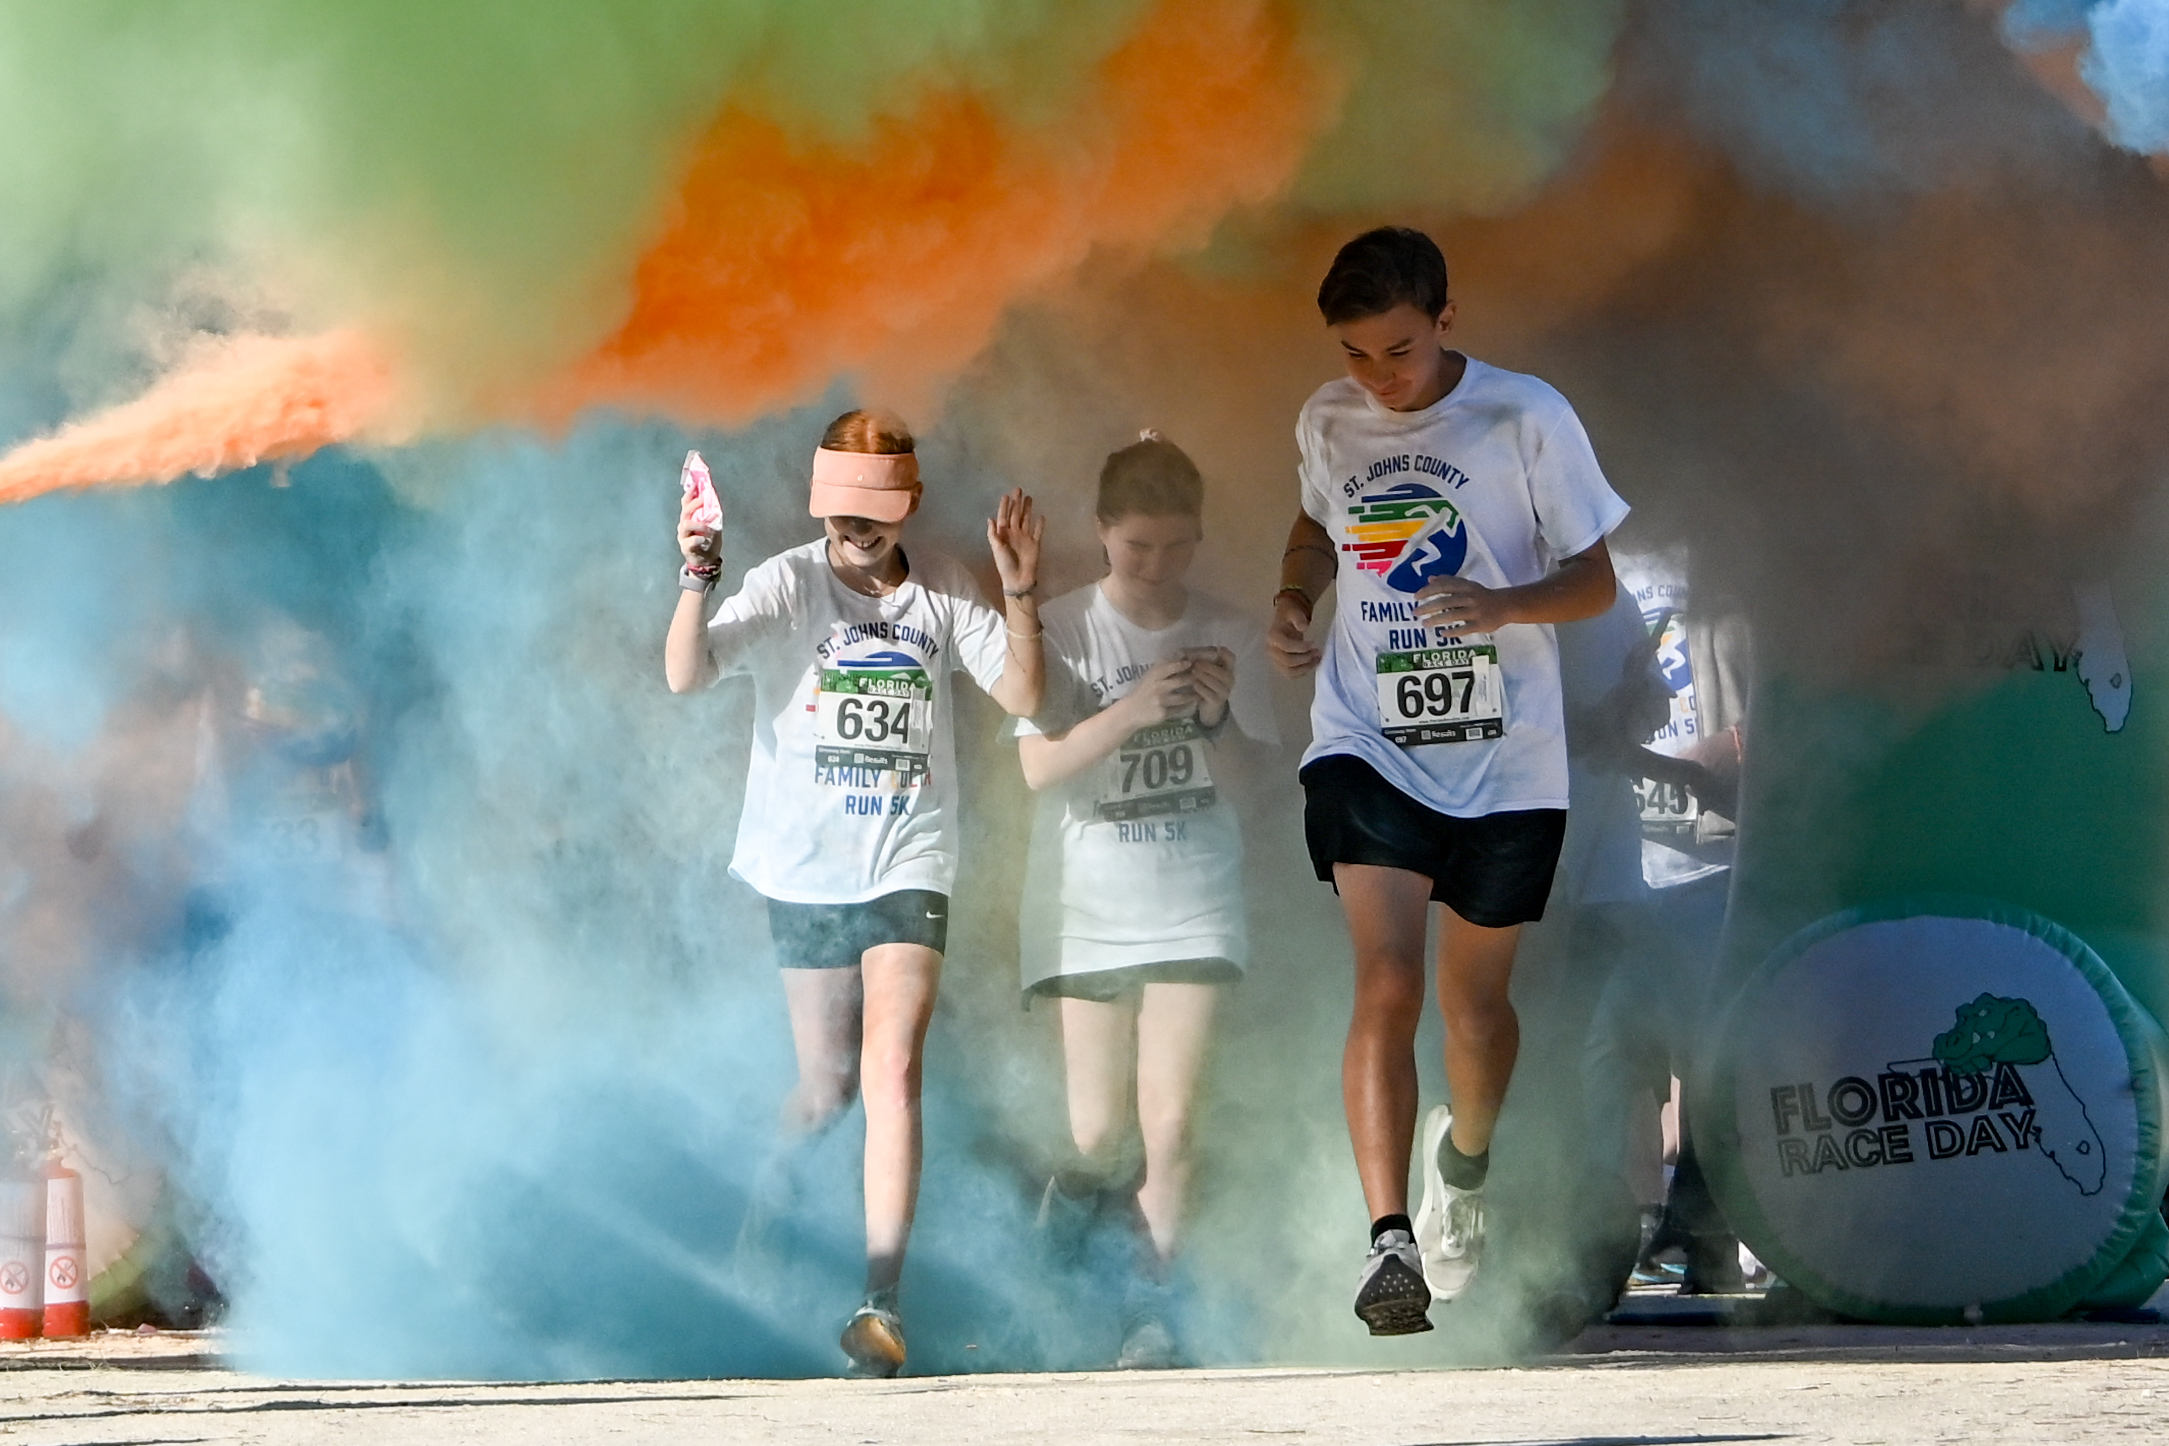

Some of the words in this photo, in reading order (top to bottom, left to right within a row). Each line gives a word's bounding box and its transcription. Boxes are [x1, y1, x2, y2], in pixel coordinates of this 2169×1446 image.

[1343, 476, 1364, 498] ST.
[1366, 454, 1410, 482] JOHNS
[1414, 454, 1470, 489] COUNTY
[816, 639, 841, 660] ST.
[843, 621, 888, 646] JOHNS
[892, 624, 939, 659] COUNTY
[1389, 628, 1427, 650] RUN
[1413, 649, 1476, 664] FLORIDA
[859, 677, 917, 691] FLORIDA
[1090, 675, 1113, 698] ST.
[1116, 663, 1153, 685] JOHN
[1396, 671, 1475, 718] 697
[836, 698, 911, 744] 634
[815, 766, 881, 788] FAMILY
[1120, 745, 1193, 793] 709
[845, 795, 883, 815] RUN
[890, 796, 911, 815] 5K
[1119, 823, 1157, 842] RUN
[1165, 821, 1187, 841] 5K
[1771, 1063, 2035, 1135] FLORIDA
[1777, 1123, 1914, 1177] RACE
[1925, 1109, 2037, 1160] DAY
